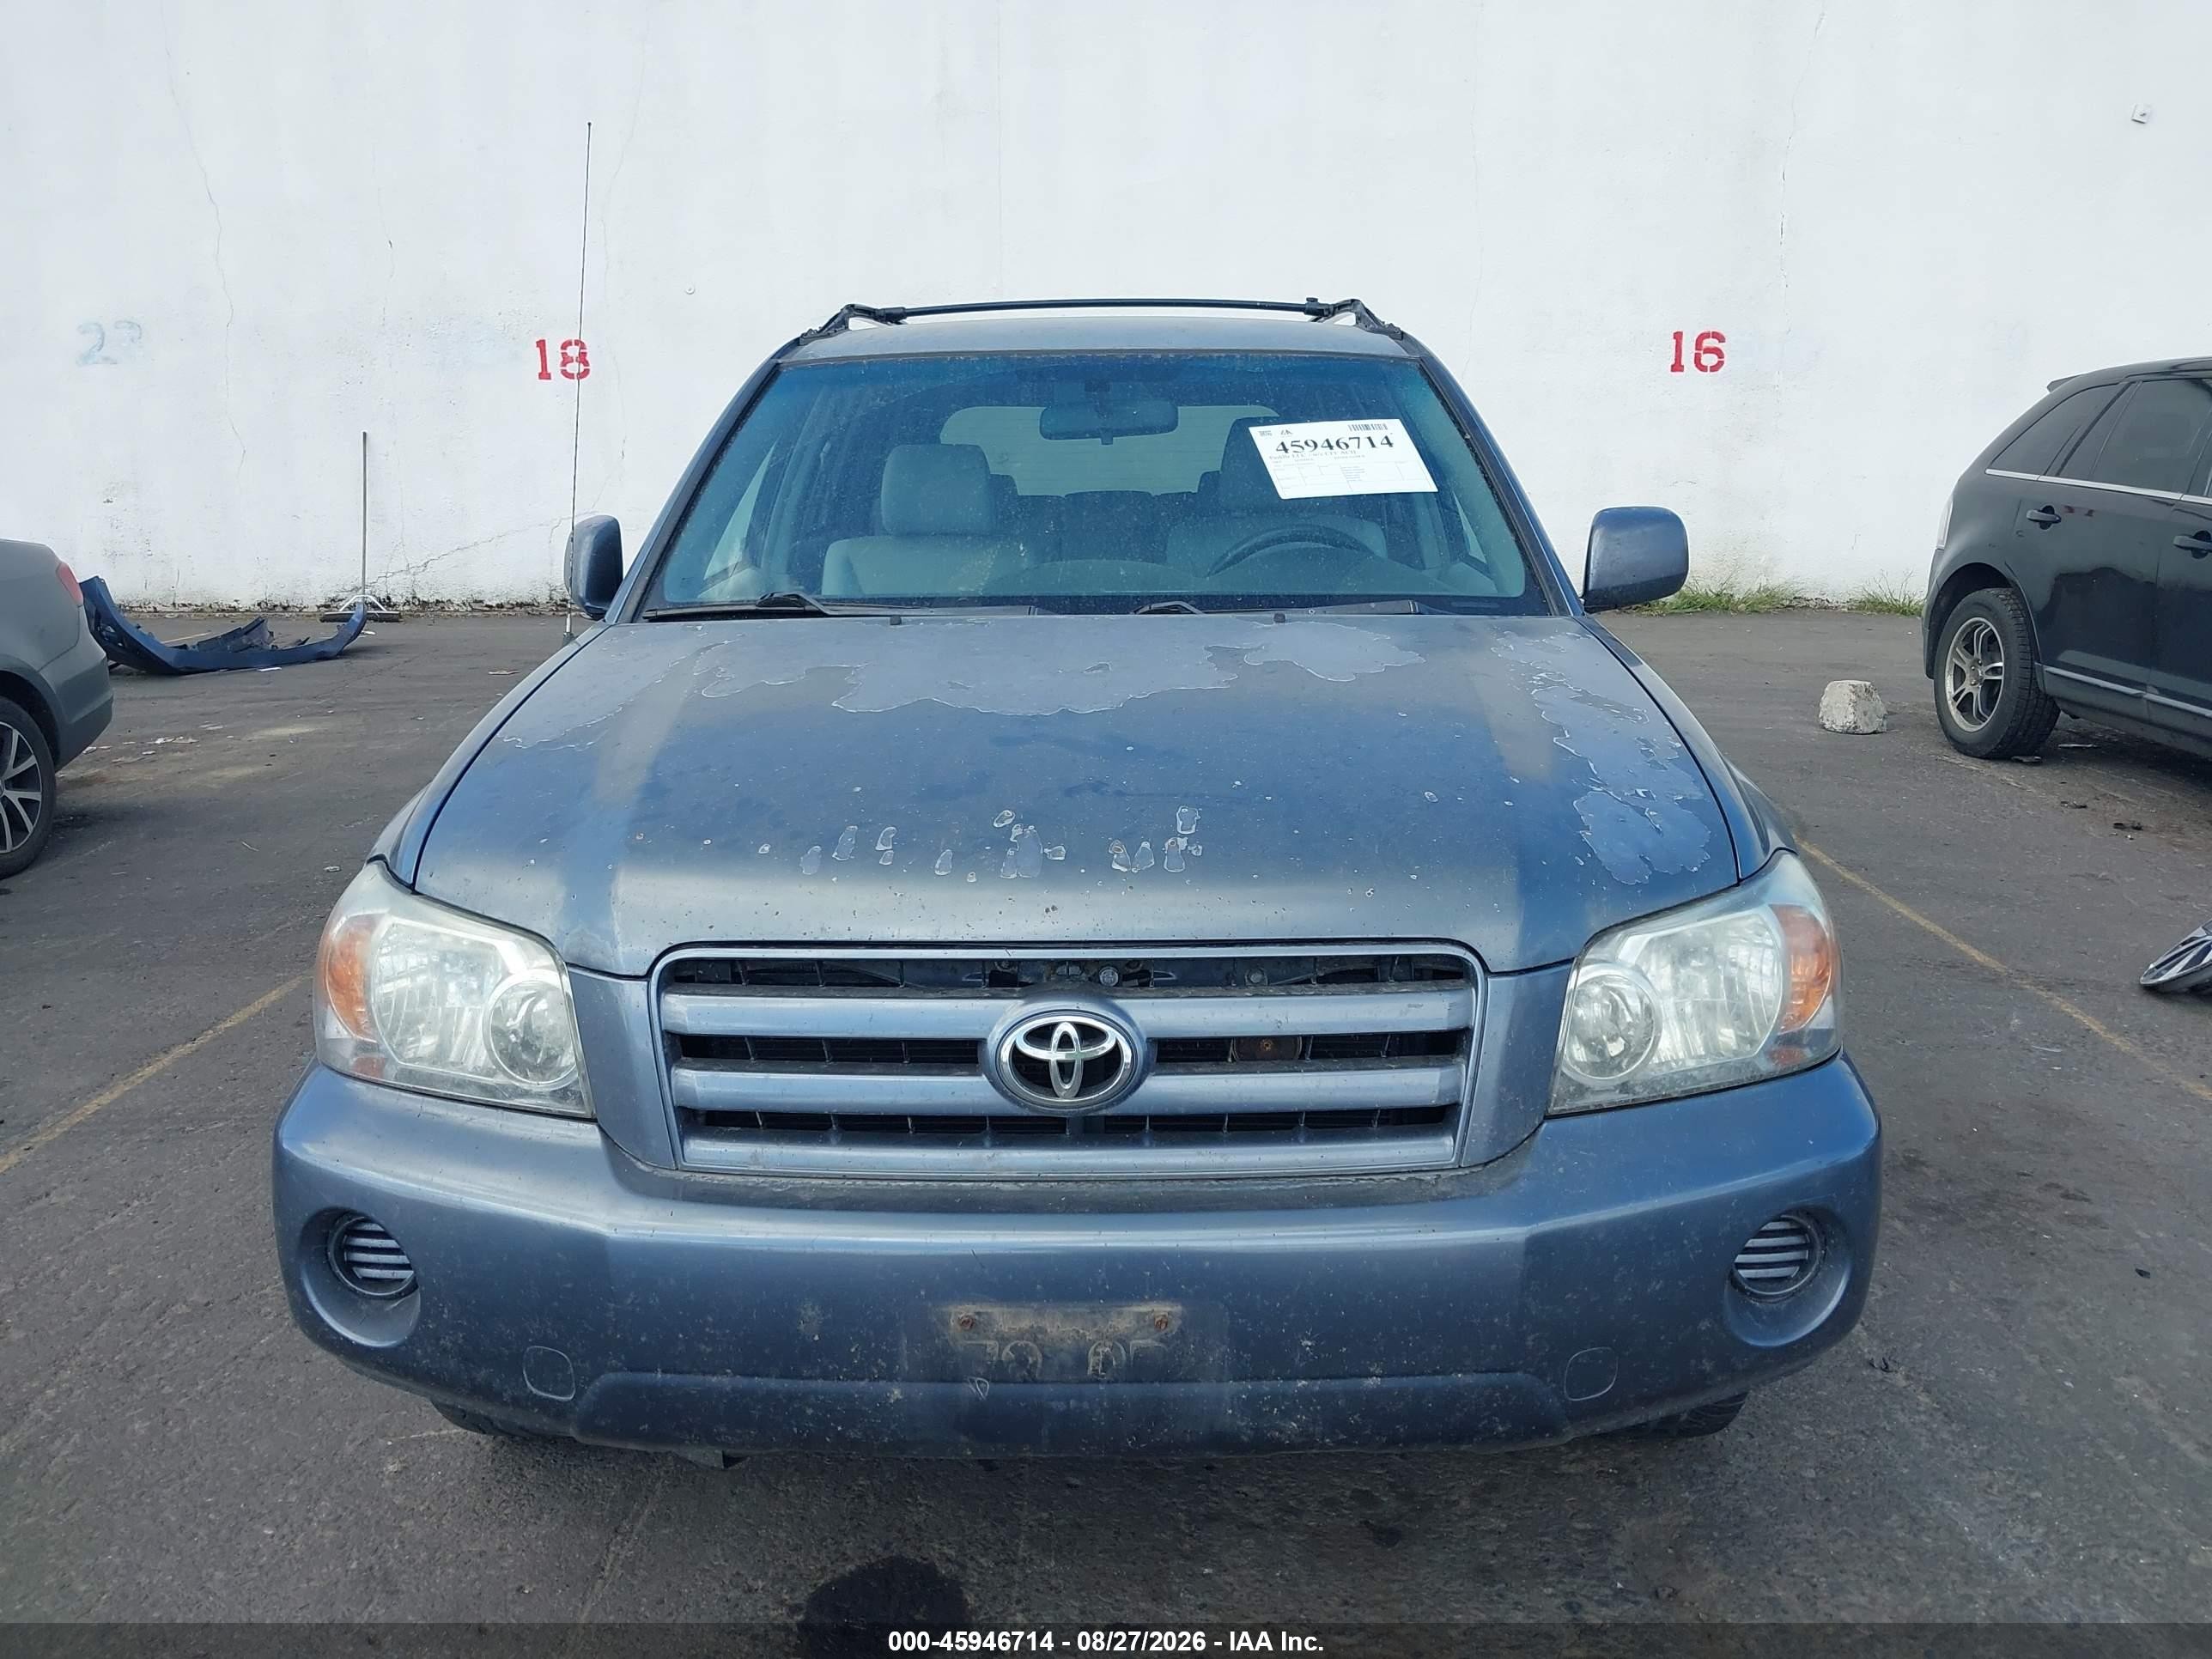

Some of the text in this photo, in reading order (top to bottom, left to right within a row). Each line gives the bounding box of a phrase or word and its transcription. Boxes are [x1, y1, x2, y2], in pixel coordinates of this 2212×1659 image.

[536, 339, 590, 380] 18
[1670, 331, 1726, 373] 16
[1275, 435, 1395, 453] 45946714
